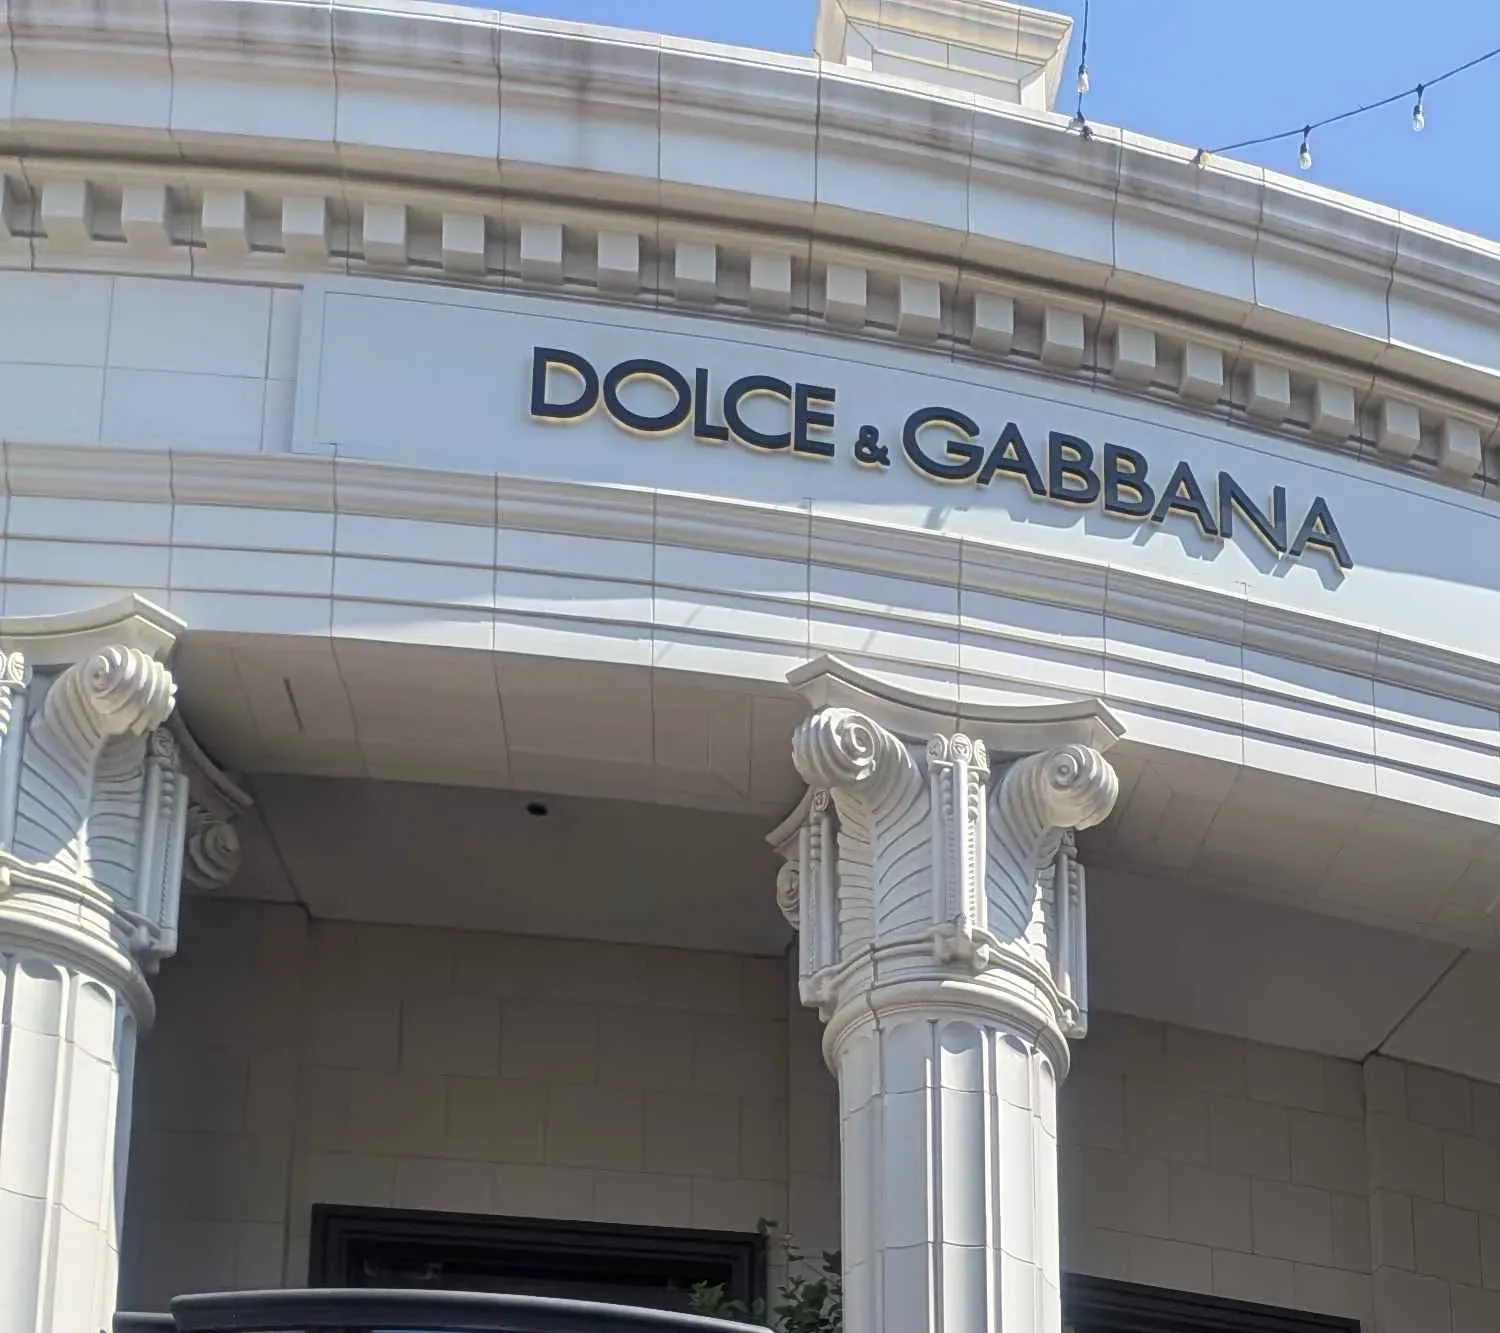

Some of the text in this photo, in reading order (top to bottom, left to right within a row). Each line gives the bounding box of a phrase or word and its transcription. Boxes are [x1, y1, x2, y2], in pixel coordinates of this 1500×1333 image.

[531, 346, 1353, 569] DOLCE & GABBANA
